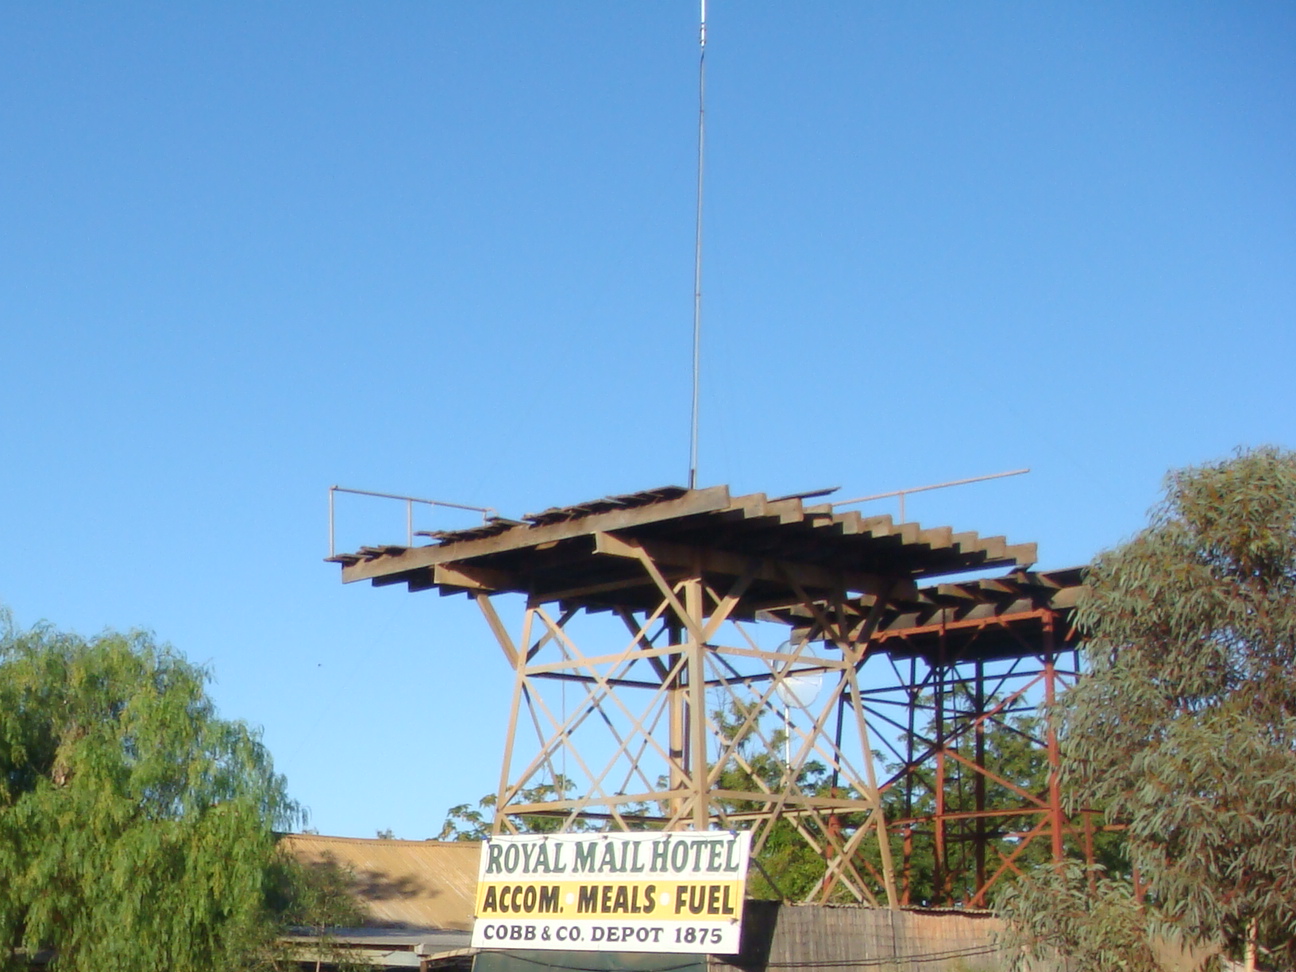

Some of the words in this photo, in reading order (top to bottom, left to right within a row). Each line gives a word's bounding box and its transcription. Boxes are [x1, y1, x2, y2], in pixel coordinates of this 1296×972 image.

[486, 843, 566, 874] ROYAL
[572, 841, 646, 873] MAIL
[649, 838, 740, 873] HOTEL
[483, 885, 564, 913] ACCOM.
[577, 884, 656, 914] MEALS
[674, 885, 734, 915] FUEL
[484, 924, 536, 942] COBB
[541, 926, 552, 942] &
[556, 926, 584, 942] CO.
[591, 926, 664, 943] DEPOT
[675, 927, 722, 944] 1875
